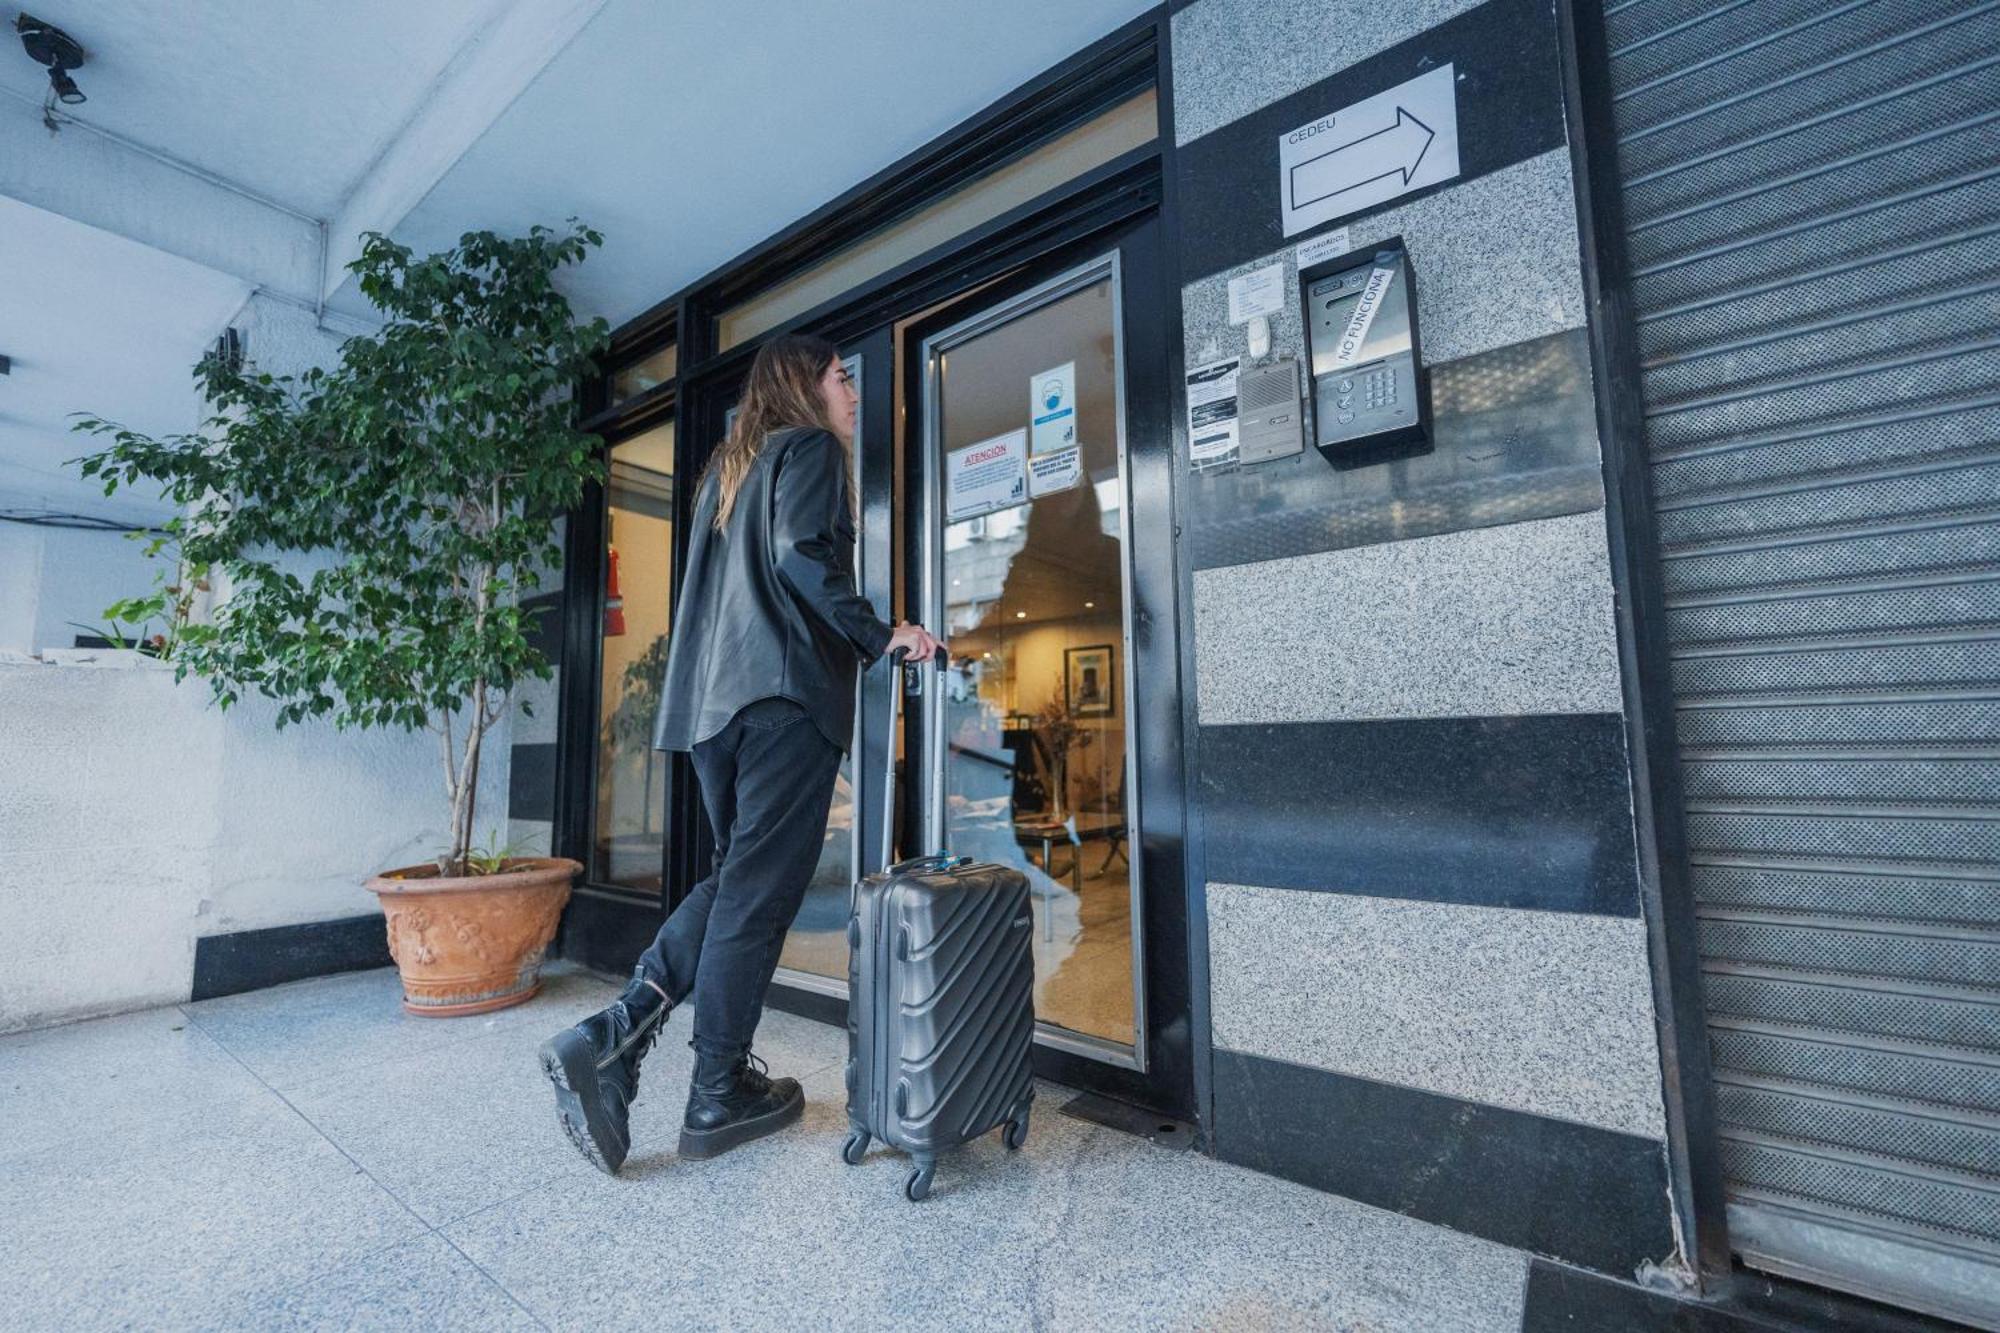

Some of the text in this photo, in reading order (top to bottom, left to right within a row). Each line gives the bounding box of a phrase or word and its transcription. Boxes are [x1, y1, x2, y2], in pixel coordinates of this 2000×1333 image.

[1288, 117, 1337, 145] CEDEU
[1337, 340, 1354, 361] NO
[1347, 273, 1386, 338] FUNCIONA
